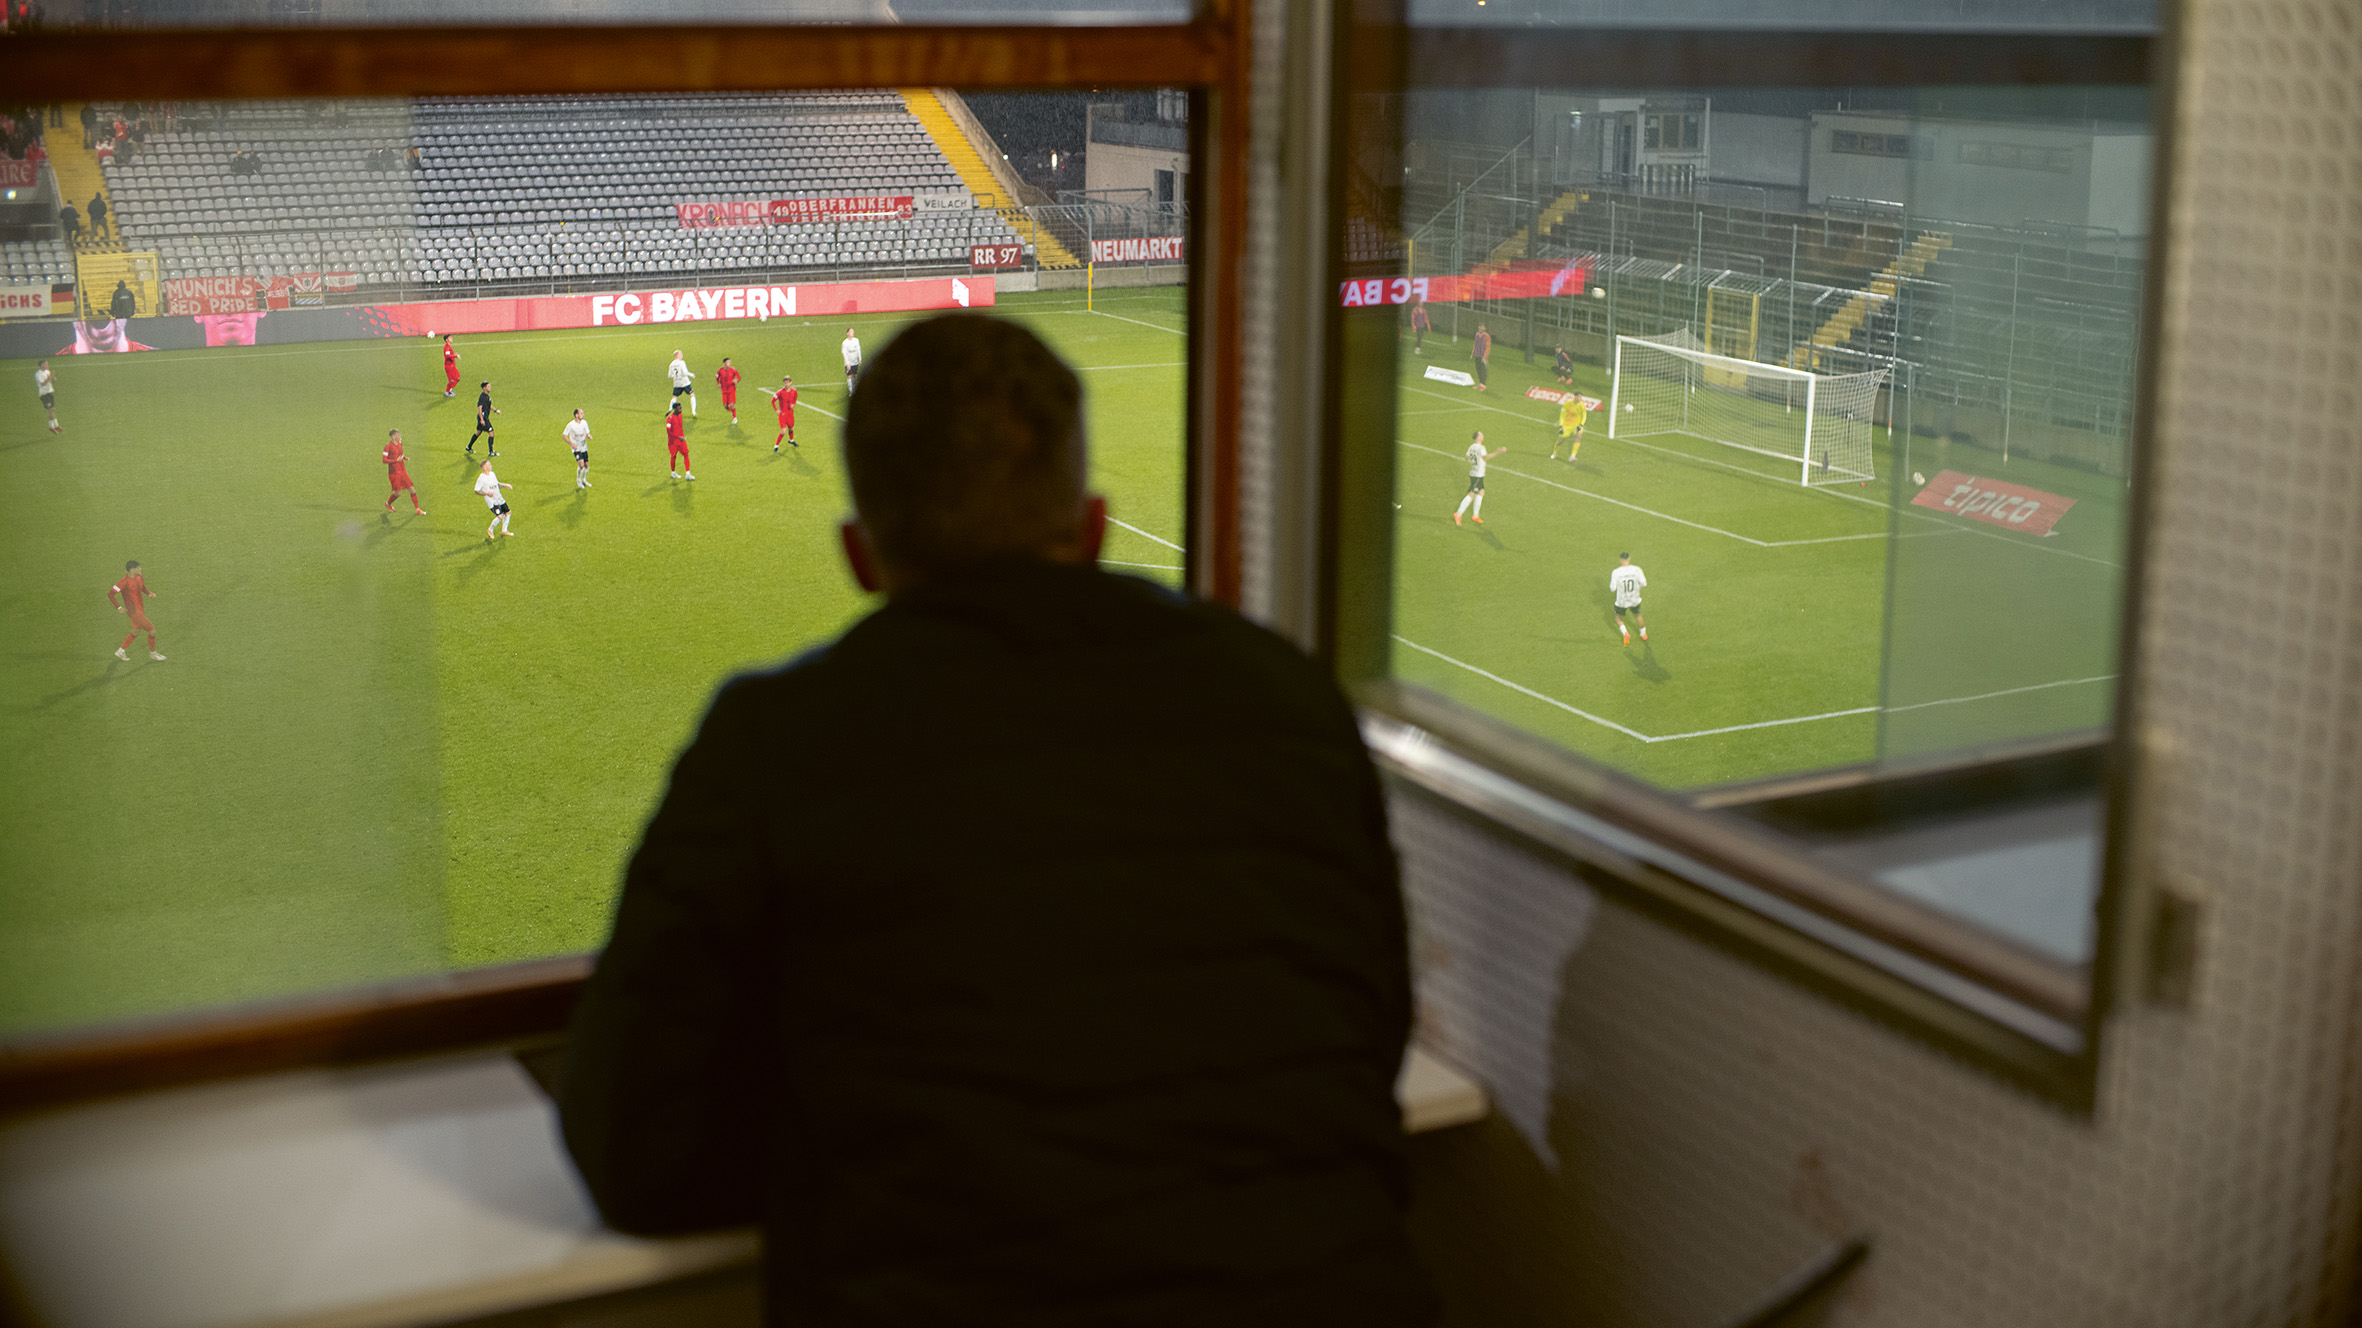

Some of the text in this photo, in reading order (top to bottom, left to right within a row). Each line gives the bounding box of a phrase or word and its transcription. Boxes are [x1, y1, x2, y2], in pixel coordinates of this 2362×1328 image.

[789, 198, 895, 211] OBERFRANKEN
[675, 202, 772, 228] KRONACH
[975, 248, 1018, 265] RR 97
[1091, 238, 1182, 262] NEUMARKT
[169, 299, 201, 315] RED
[592, 287, 797, 326] FC BAYERN
[1944, 476, 2041, 523] tipico
[1622, 579, 1634, 593] 10
